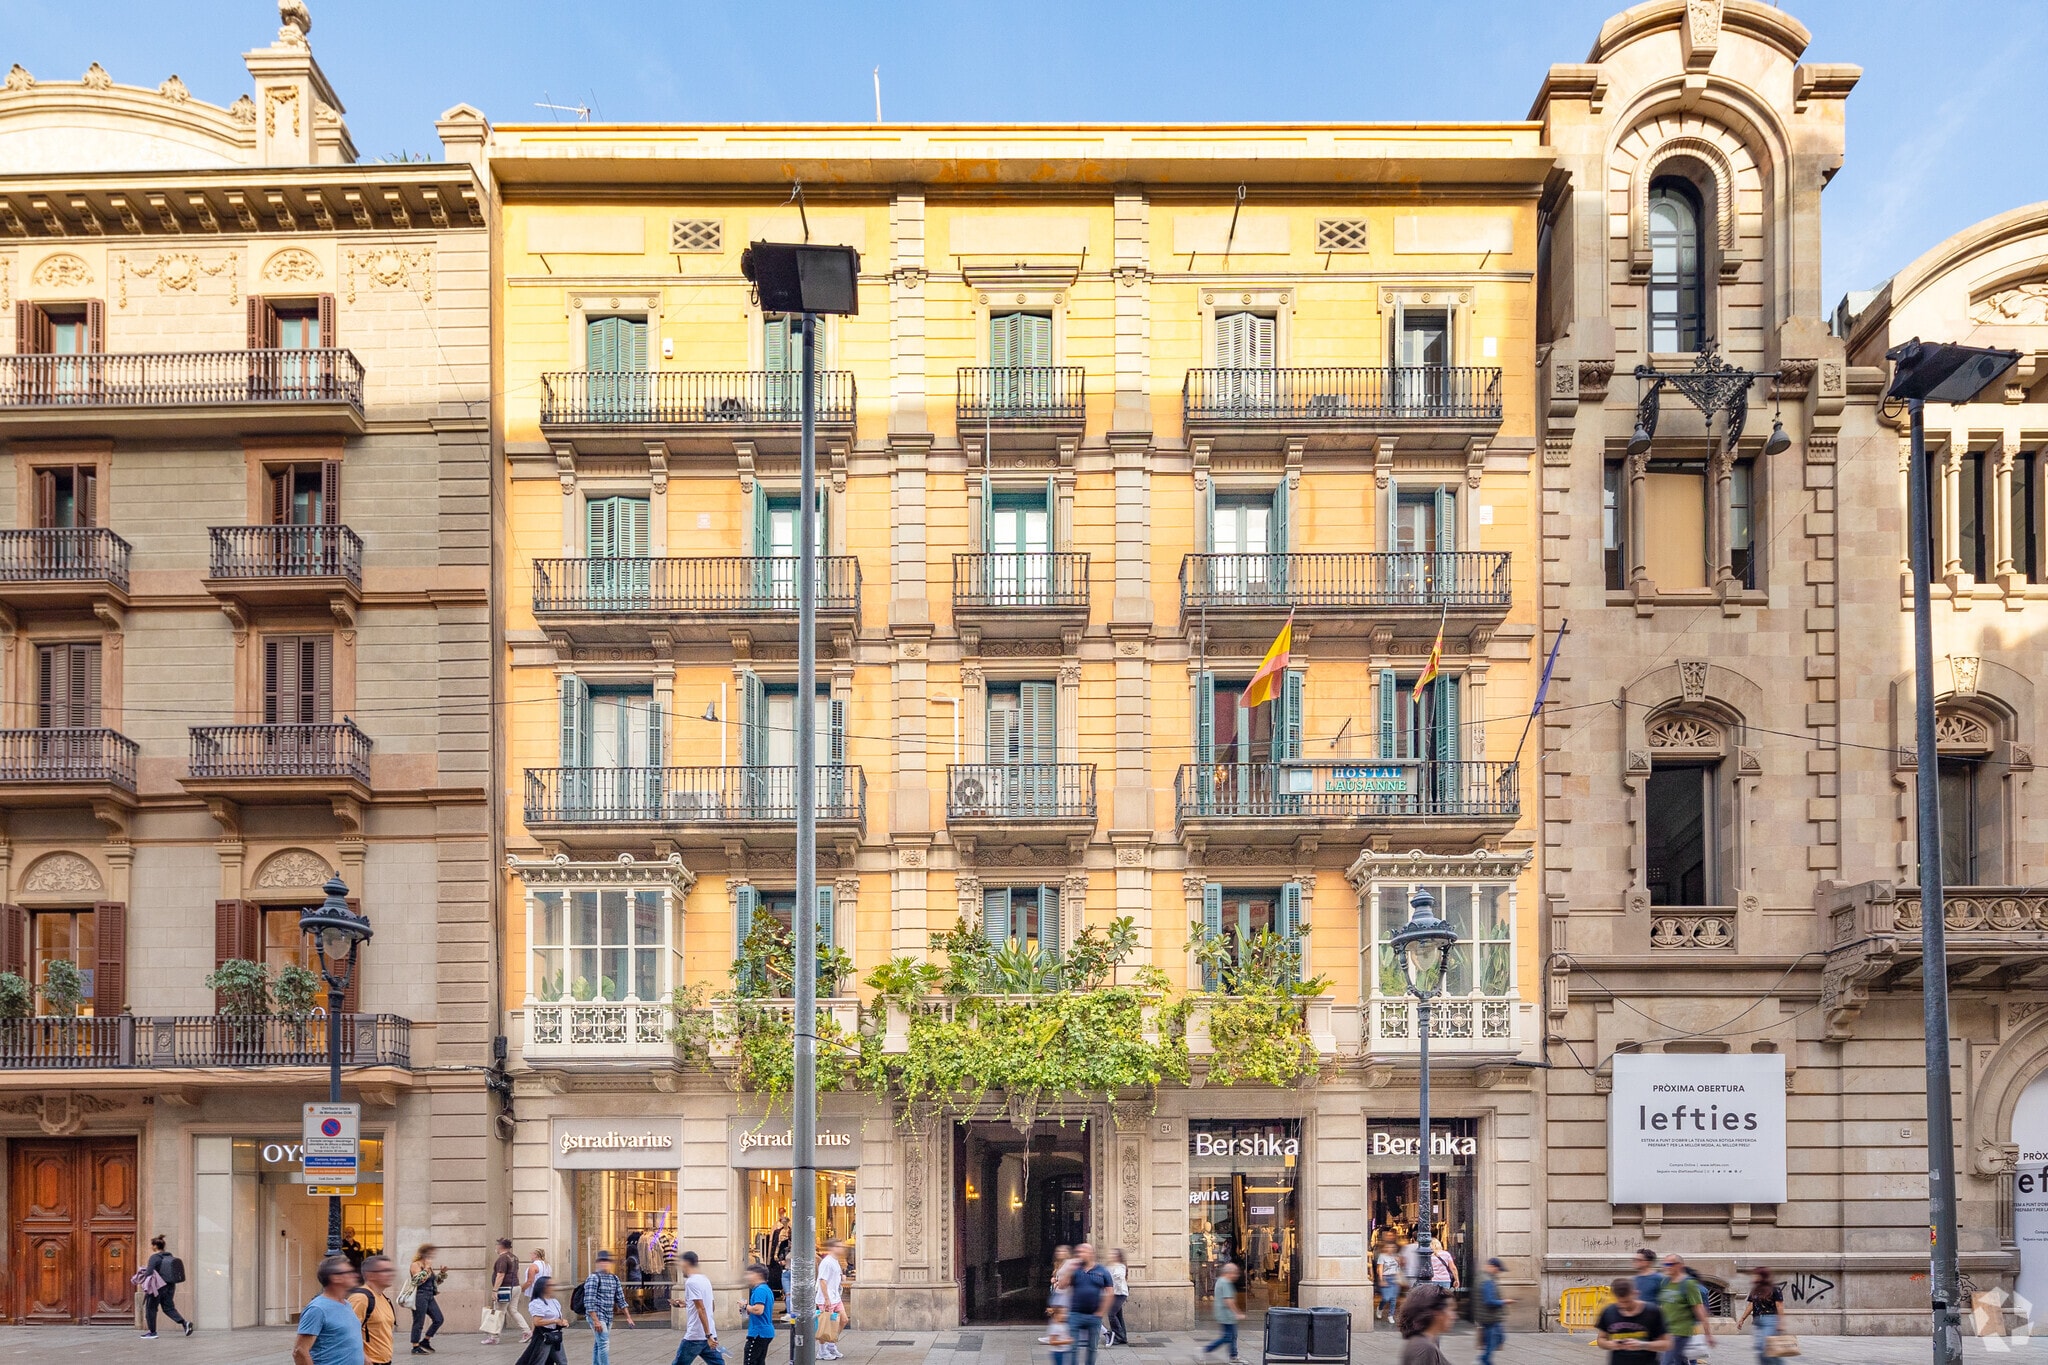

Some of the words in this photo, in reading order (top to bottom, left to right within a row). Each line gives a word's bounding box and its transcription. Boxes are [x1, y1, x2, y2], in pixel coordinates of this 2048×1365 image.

[1334, 768, 1401, 778] HOSTAL
[1325, 780, 1407, 792] LAUSANNE
[1653, 1083, 1695, 1093] PRÒXIMA
[1697, 1084, 1745, 1093] OBERTURA
[142, 1096, 154, 1105] 28
[1640, 1104, 1758, 1131] lefties
[742, 1130, 851, 1149] stradrius
[1196, 1133, 1299, 1156] Bershka
